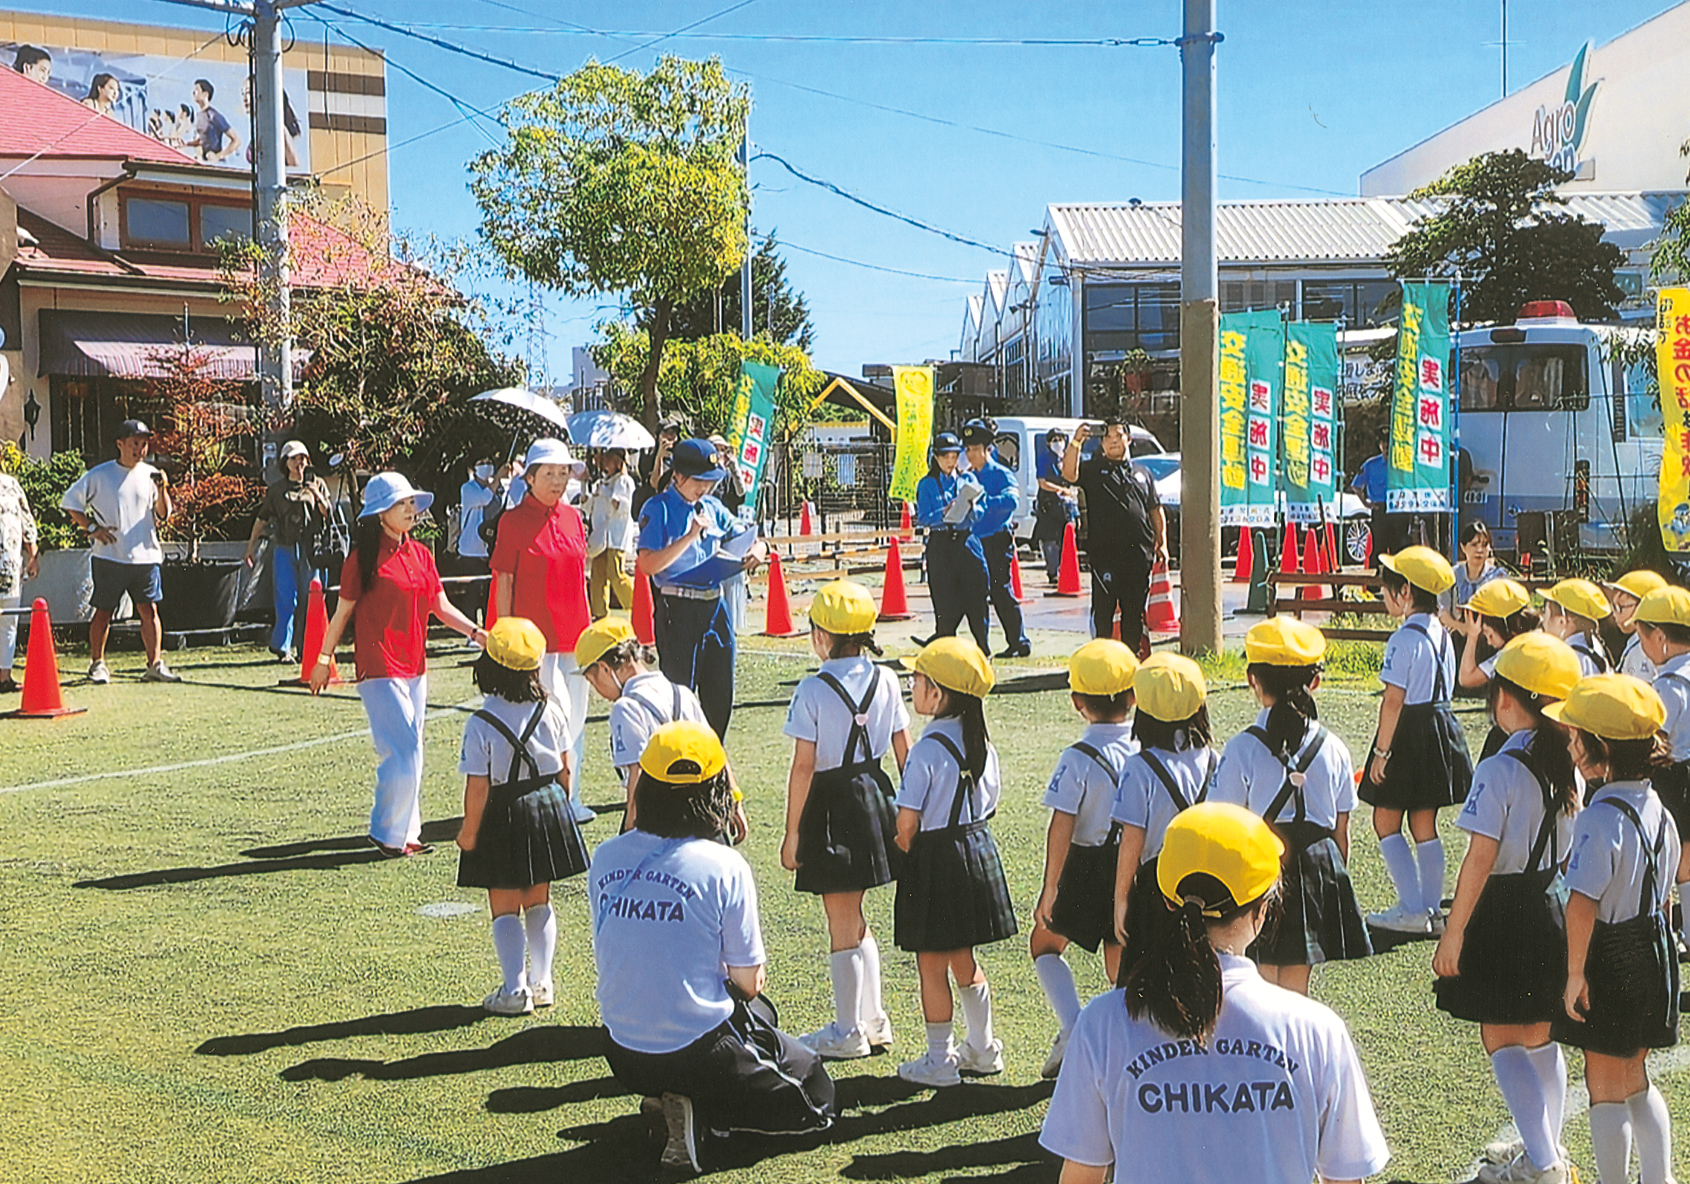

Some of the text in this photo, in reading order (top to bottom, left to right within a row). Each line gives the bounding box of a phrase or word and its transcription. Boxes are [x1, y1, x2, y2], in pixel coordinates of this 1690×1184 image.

[1530, 102, 1575, 161] Agro
[645, 870, 697, 900] GARTEN
[1138, 1081, 1295, 1113] CHIKATA
